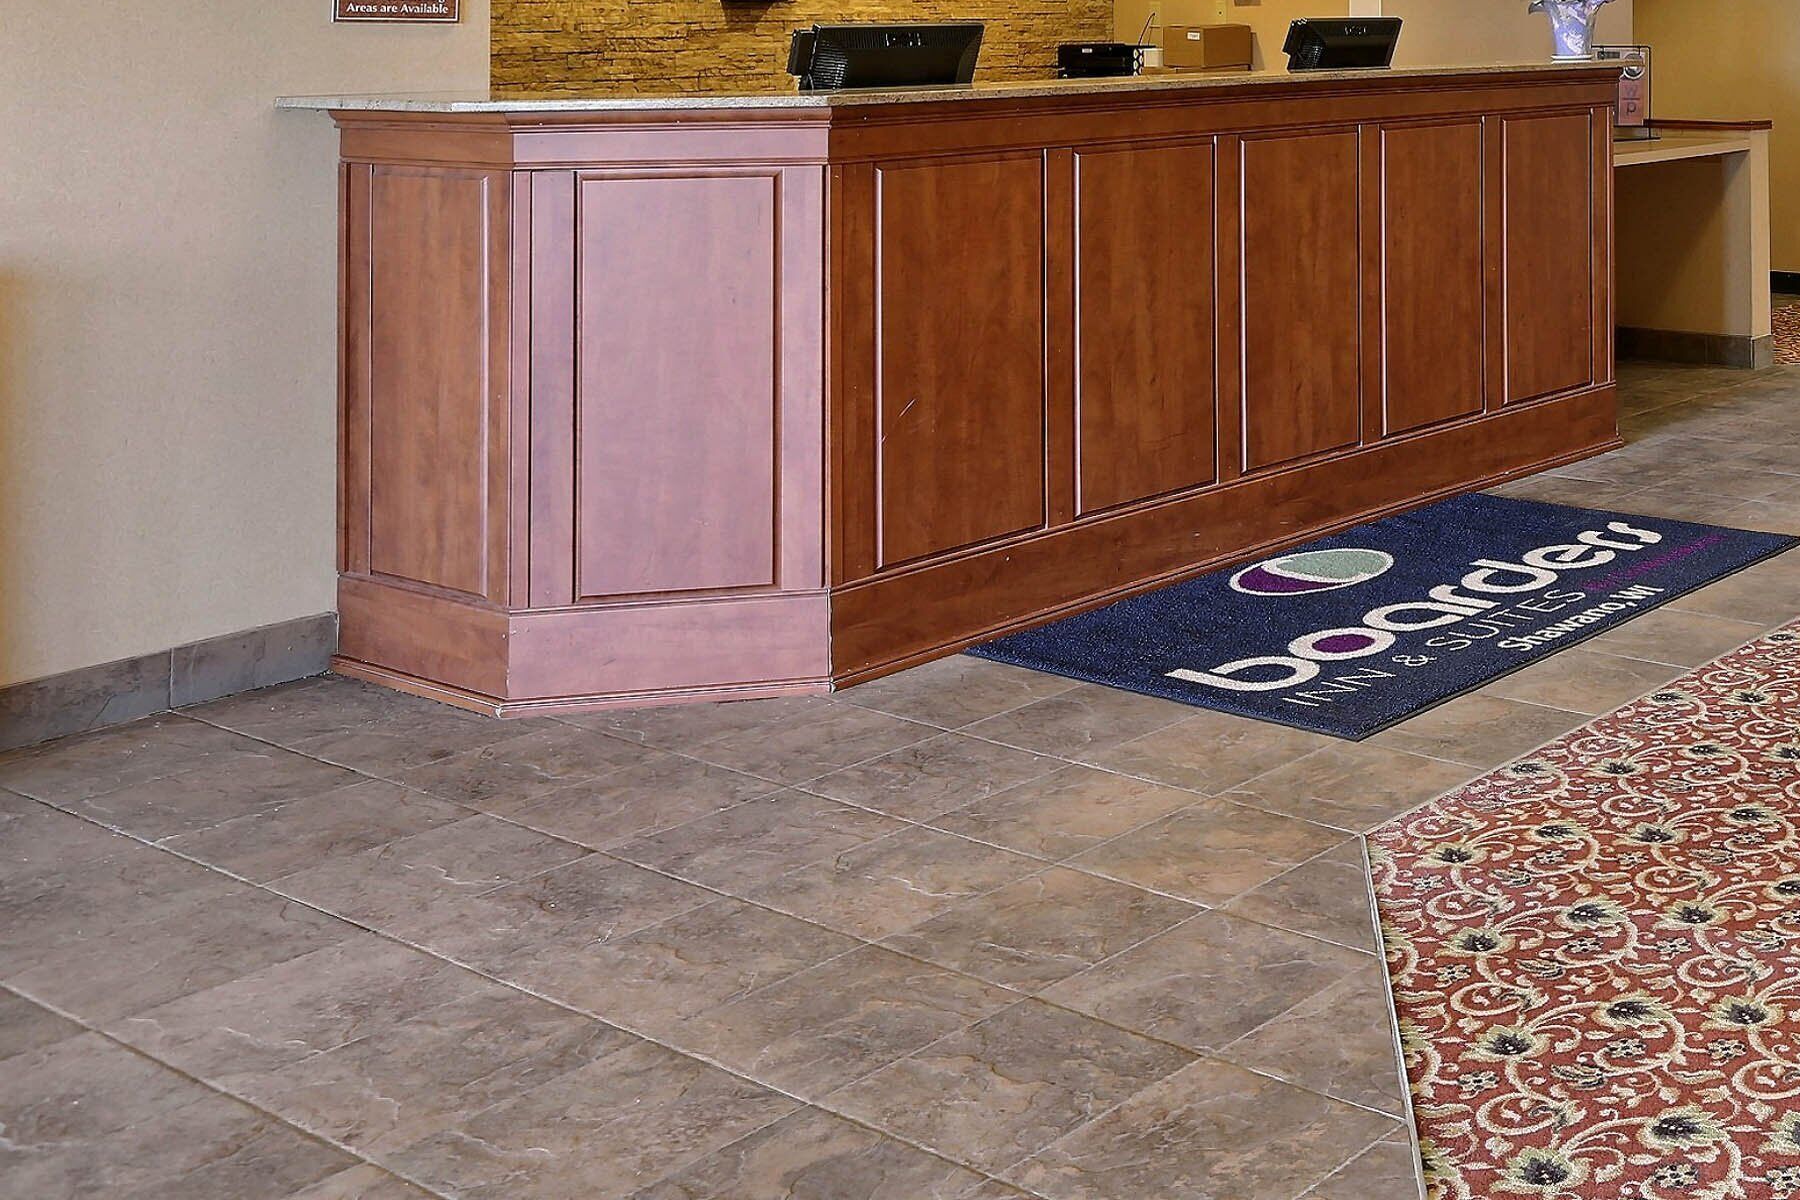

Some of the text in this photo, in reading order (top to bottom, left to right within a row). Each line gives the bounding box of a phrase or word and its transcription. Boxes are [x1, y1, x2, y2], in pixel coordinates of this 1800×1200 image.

[346, 3, 449, 14] Areas are Available
[1164, 521, 1663, 693] boarders
[1282, 667, 1397, 707] INN
[1391, 653, 1438, 668] &
[1425, 588, 1587, 652] SUITES
